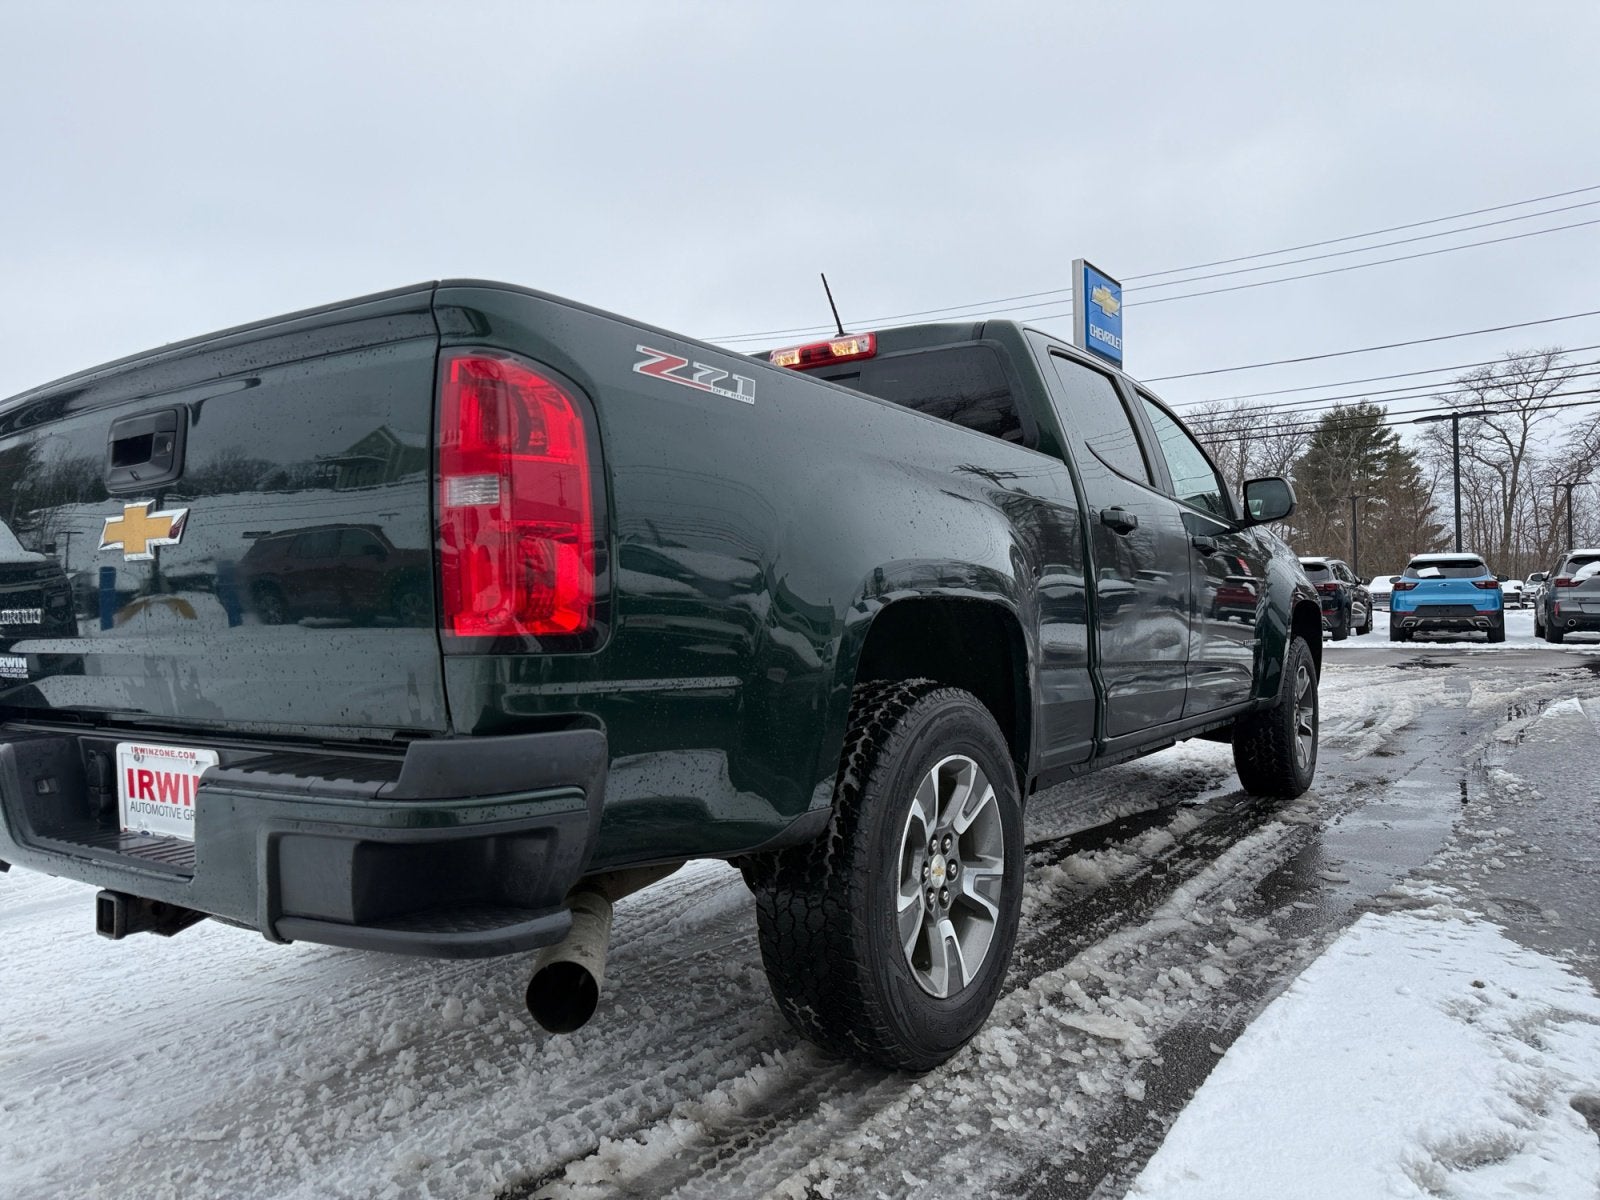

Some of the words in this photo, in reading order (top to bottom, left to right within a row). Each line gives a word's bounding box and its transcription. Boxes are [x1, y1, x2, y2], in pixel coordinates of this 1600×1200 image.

[1090, 323, 1121, 350] CHEVROLET
[633, 344, 755, 402] Z71
[131, 746, 196, 760] IRWINZONE.COM
[130, 801, 182, 820] AUTOMOTIVE
